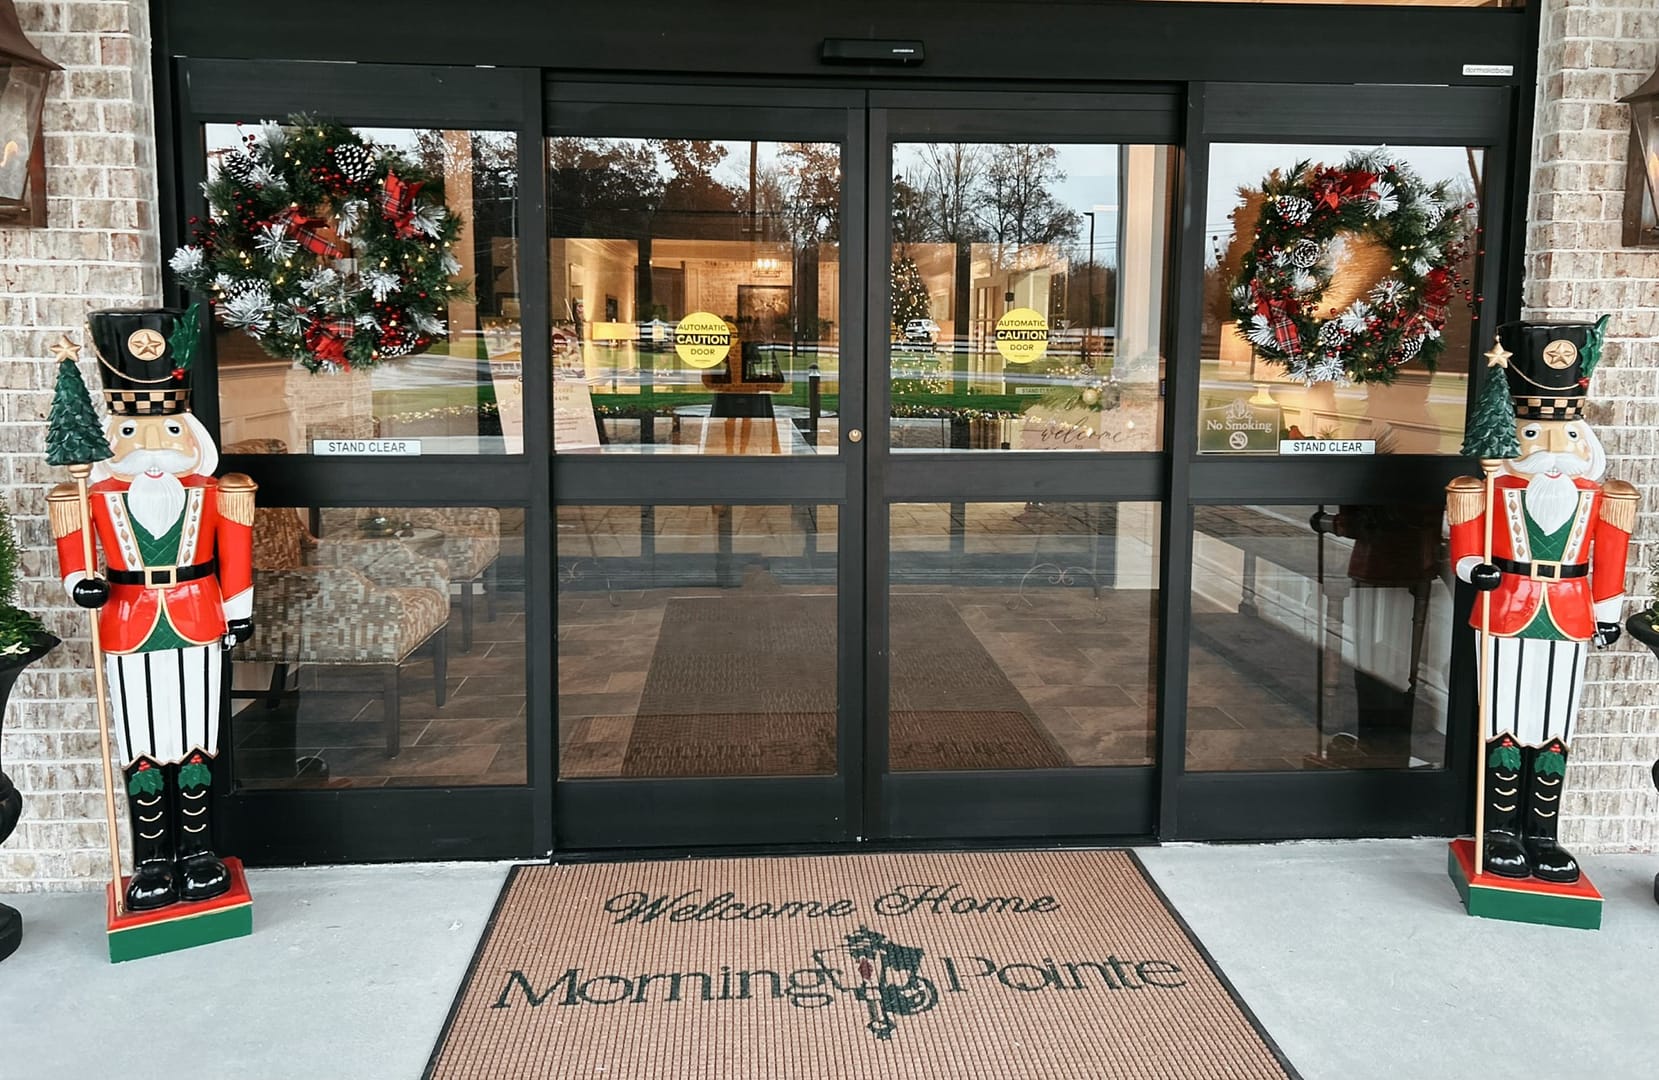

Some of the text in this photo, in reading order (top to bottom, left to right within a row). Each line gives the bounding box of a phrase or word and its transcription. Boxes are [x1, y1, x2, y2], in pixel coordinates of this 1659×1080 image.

[676, 334, 729, 345] CAUTION
[997, 330, 1048, 340] CAUTION
[690, 348, 716, 356] DOOR
[1010, 343, 1034, 351] DOOR
[1040, 416, 1122, 444] welcome
[1206, 420, 1272, 433] No Smoking
[328, 441, 406, 453] STAND CLEAR
[1293, 441, 1363, 452] STAND CLEAR
[604, 884, 1061, 924] Welcome Home
[495, 955, 1187, 1009] Morning Pointe
